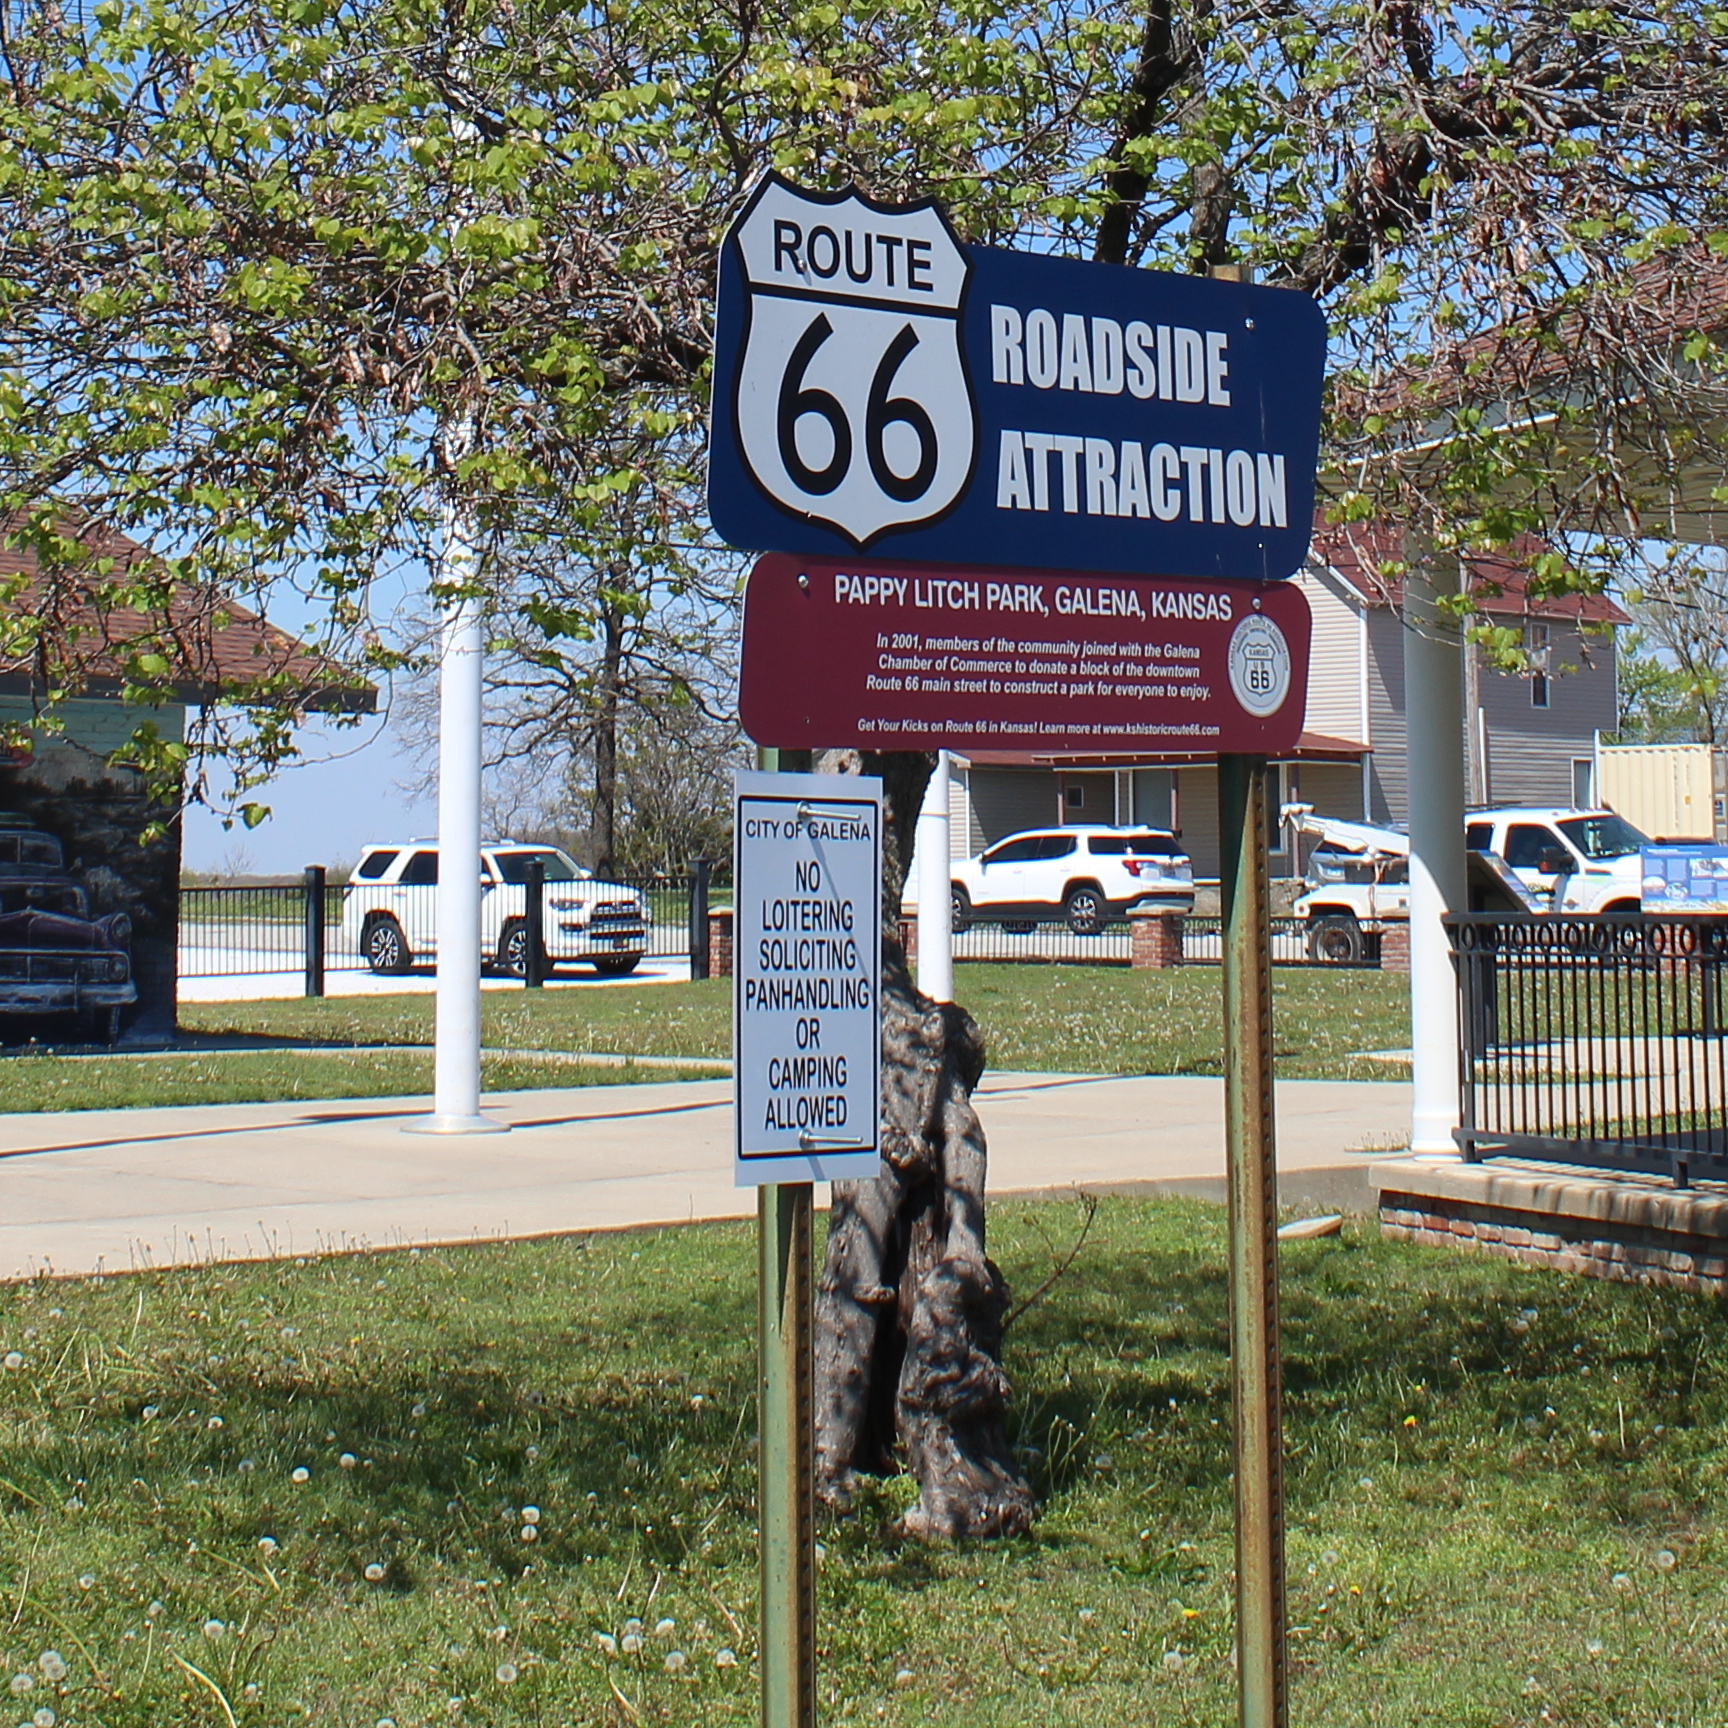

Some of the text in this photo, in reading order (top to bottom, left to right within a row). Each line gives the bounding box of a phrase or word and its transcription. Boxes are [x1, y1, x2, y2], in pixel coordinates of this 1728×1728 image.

[774, 219, 935, 292] ROUTE
[990, 303, 1231, 407] ROADSIDE
[777, 312, 938, 503] 66
[996, 429, 1287, 528] ATTRACTION
[835, 574, 1232, 622] PAPPY LITCH PARK, GALENA, KANSAS
[876, 632, 1200, 659] In 2001, members of the community joined with the Galena
[878, 653, 1200, 678] Chamber of Commerce to donate a block of the downtown
[1251, 671, 1270, 690] 66
[866, 674, 1211, 701] Route 66 main street to construct a park for everyone to enjoy.
[857, 718, 875, 732] Get
[877, 718, 901, 732] Your
[902, 719, 929, 732] Kicks
[930, 721, 944, 732] on
[945, 720, 974, 733] Route
[975, 720, 987, 734] 66
[989, 721, 998, 733] in
[1000, 721, 1038, 735] Kansas!
[1039, 722, 1066, 735] Learn
[1067, 724, 1091, 735] more
[1092, 723, 1101, 735] at
[745, 819, 871, 841] CITY OF GALENA
[795, 860, 821, 893] NO
[762, 899, 854, 933] LOITERING
[759, 938, 857, 971] SOLICITING
[745, 978, 870, 1011] PANHANDLING
[795, 1017, 821, 1050] OR
[768, 1057, 848, 1090] CAMPING
[765, 1095, 848, 1131] ALLOWED
